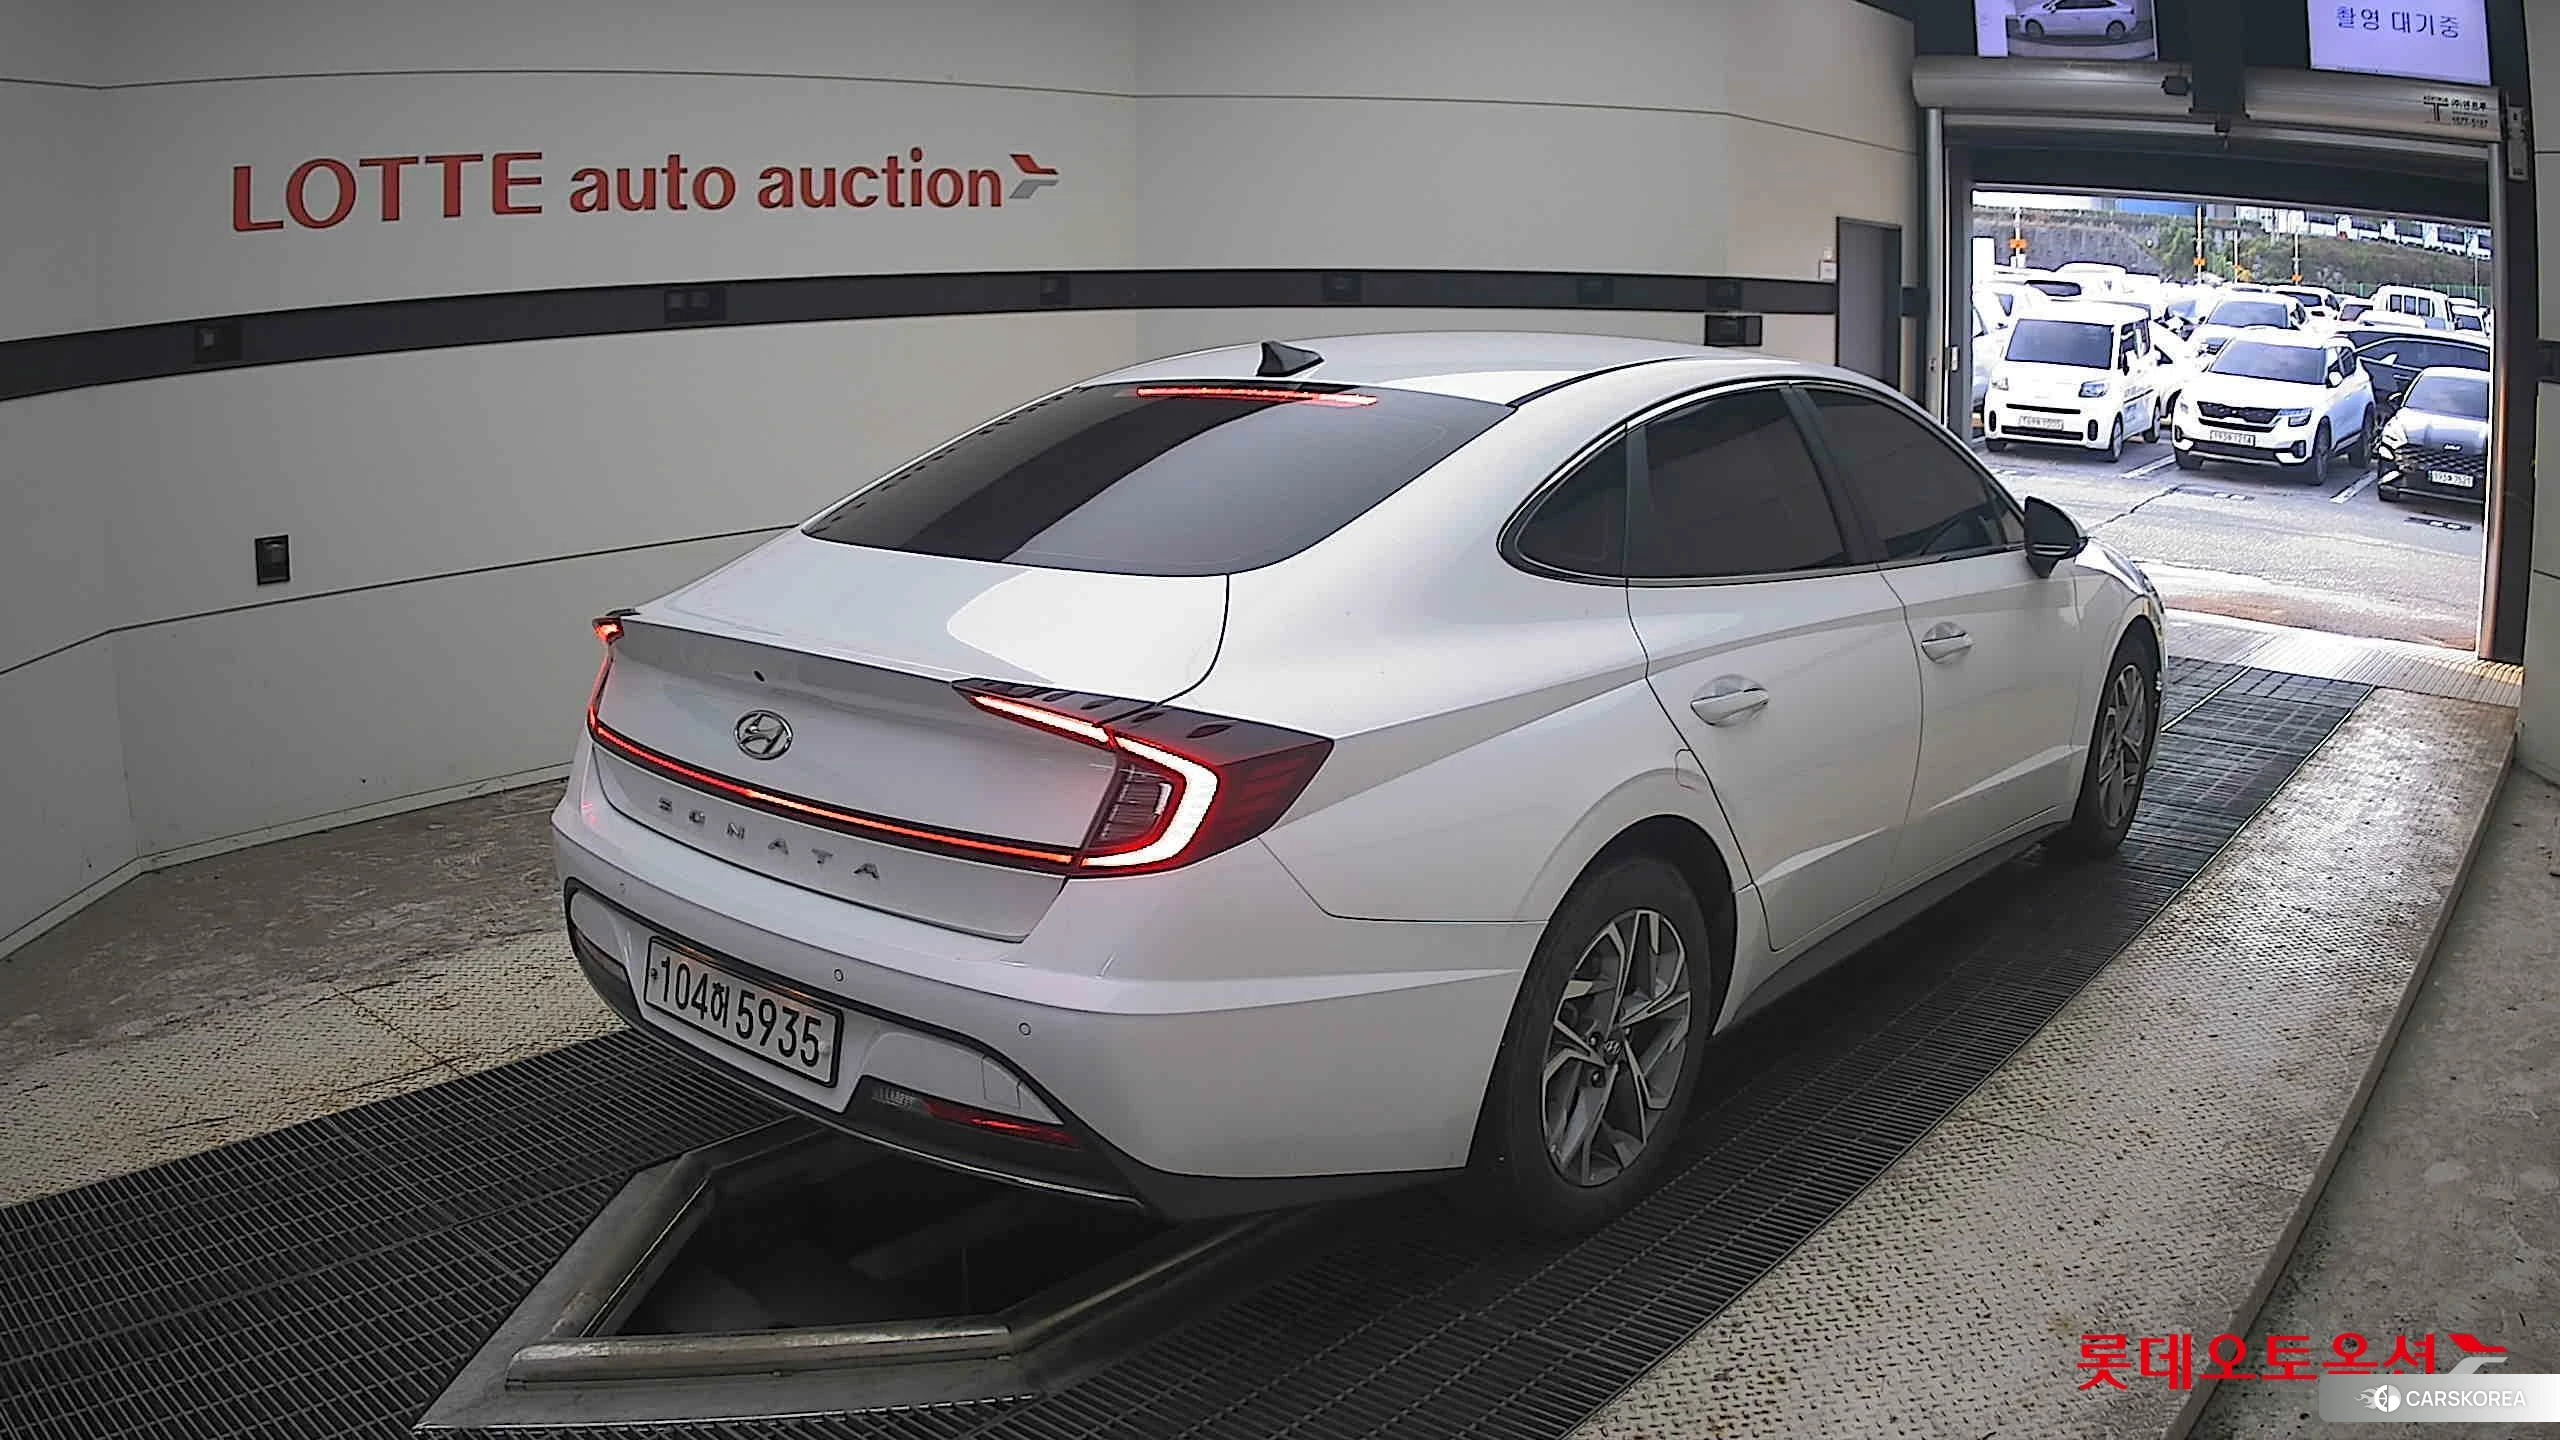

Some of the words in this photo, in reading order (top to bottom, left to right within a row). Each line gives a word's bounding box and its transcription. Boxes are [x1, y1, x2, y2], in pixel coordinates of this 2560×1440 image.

[2391, 11, 2460, 39] 대기중
[233, 151, 543, 232] LOTTE
[569, 153, 737, 213] auto
[757, 147, 1004, 210] auction
[658, 796, 881, 880] SONATA
[736, 990, 821, 1067] 5935
